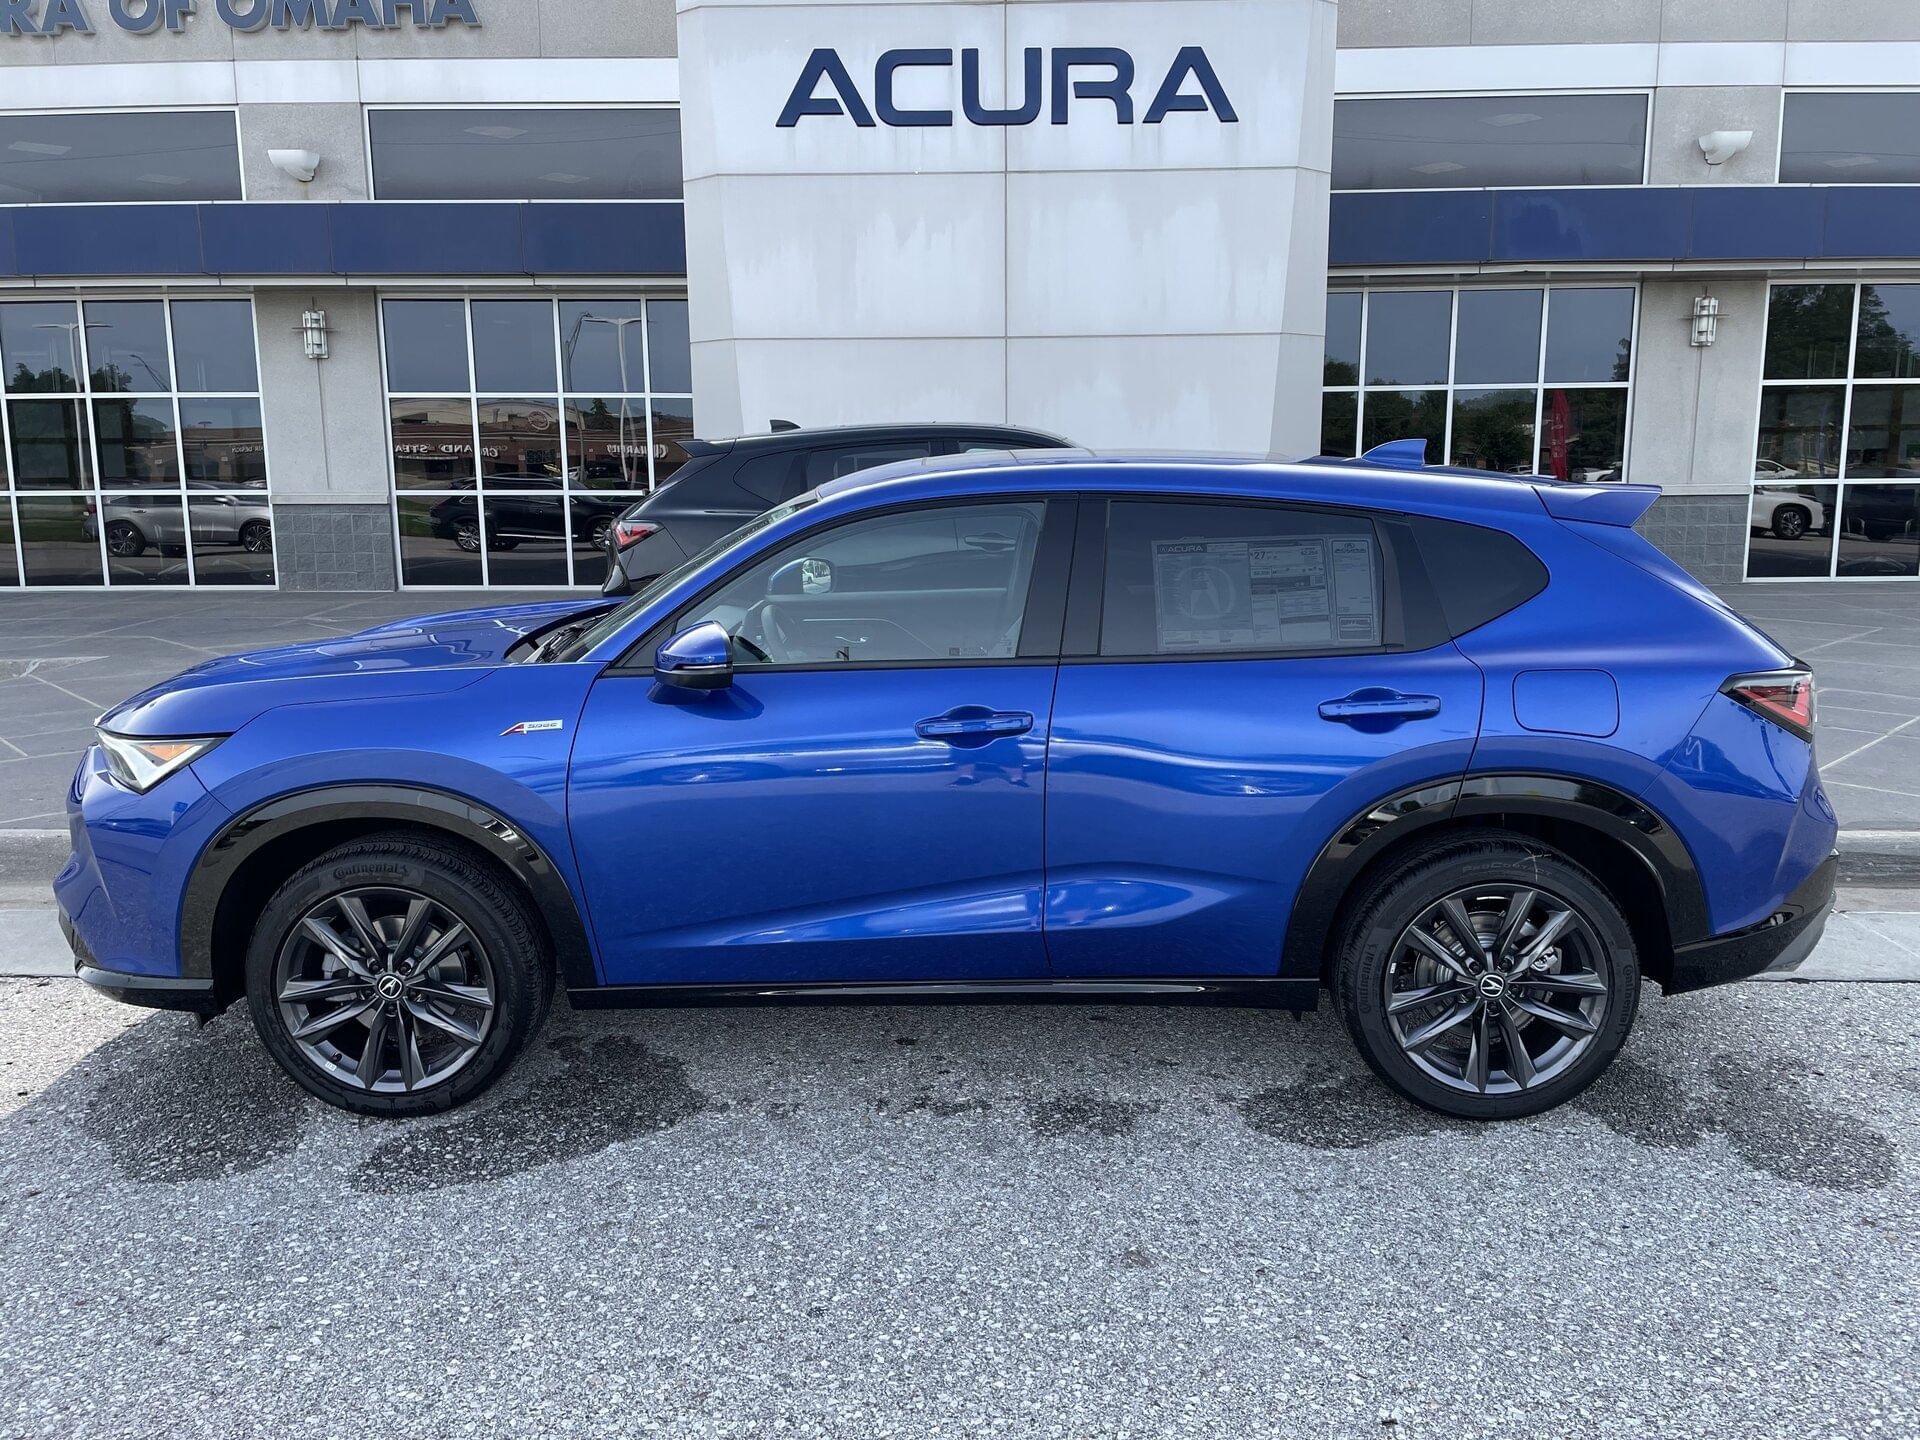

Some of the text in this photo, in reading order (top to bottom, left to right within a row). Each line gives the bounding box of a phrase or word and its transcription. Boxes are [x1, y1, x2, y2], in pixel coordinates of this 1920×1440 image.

[108, 0, 192, 33] OF
[215, 0, 482, 31] OMAHA
[775, 46, 1240, 127] ACURA
[1167, 544, 1204, 553] ACURA
[1254, 551, 1266, 560] 27
[333, 862, 399, 879] Continental
